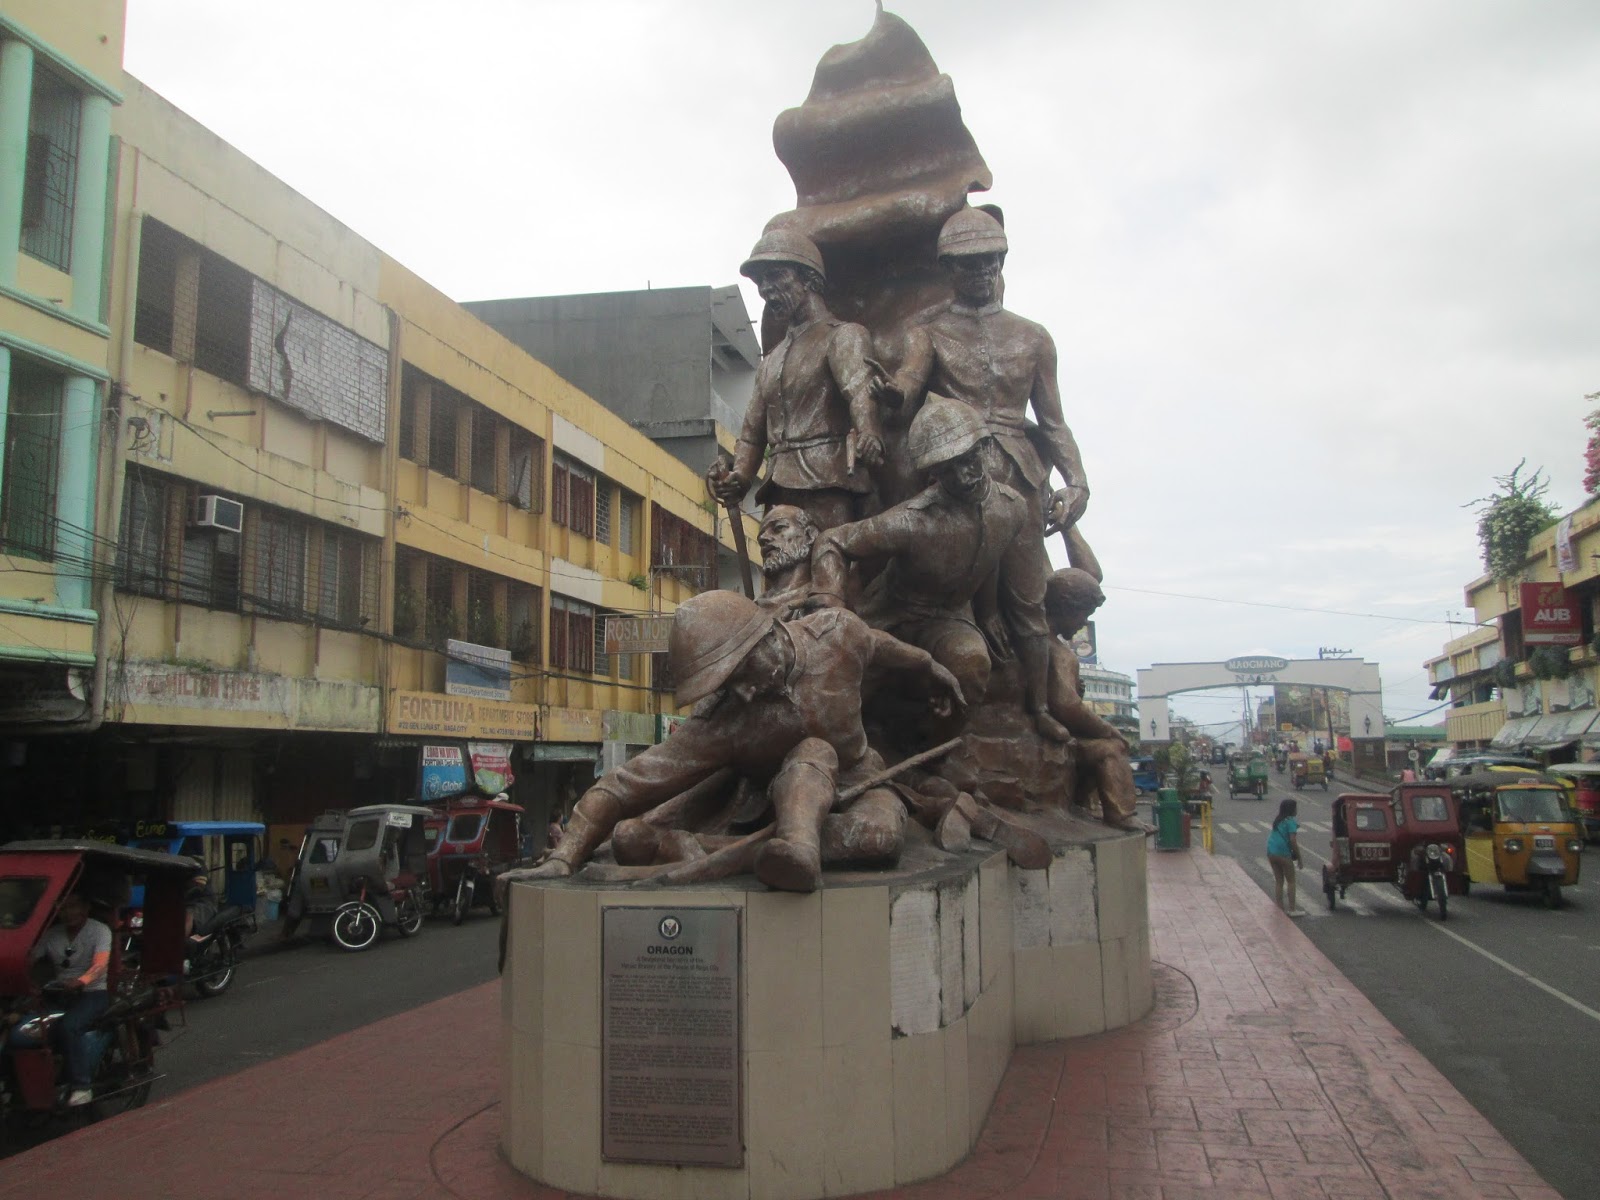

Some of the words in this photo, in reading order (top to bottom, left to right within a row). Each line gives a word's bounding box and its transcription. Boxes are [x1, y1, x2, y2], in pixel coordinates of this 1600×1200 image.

[1534, 608, 1571, 622] AUB
[607, 620, 639, 641] ROSA
[1229, 660, 1284, 669] MAOGMANG
[1235, 673, 1278, 682] NAGA
[400, 696, 474, 723] FORTUNA
[479, 706, 514, 724] DEPARTMENT
[516, 710, 534, 726] STORE
[442, 781, 462, 791] Globe
[647, 945, 693, 955] ORAGON
